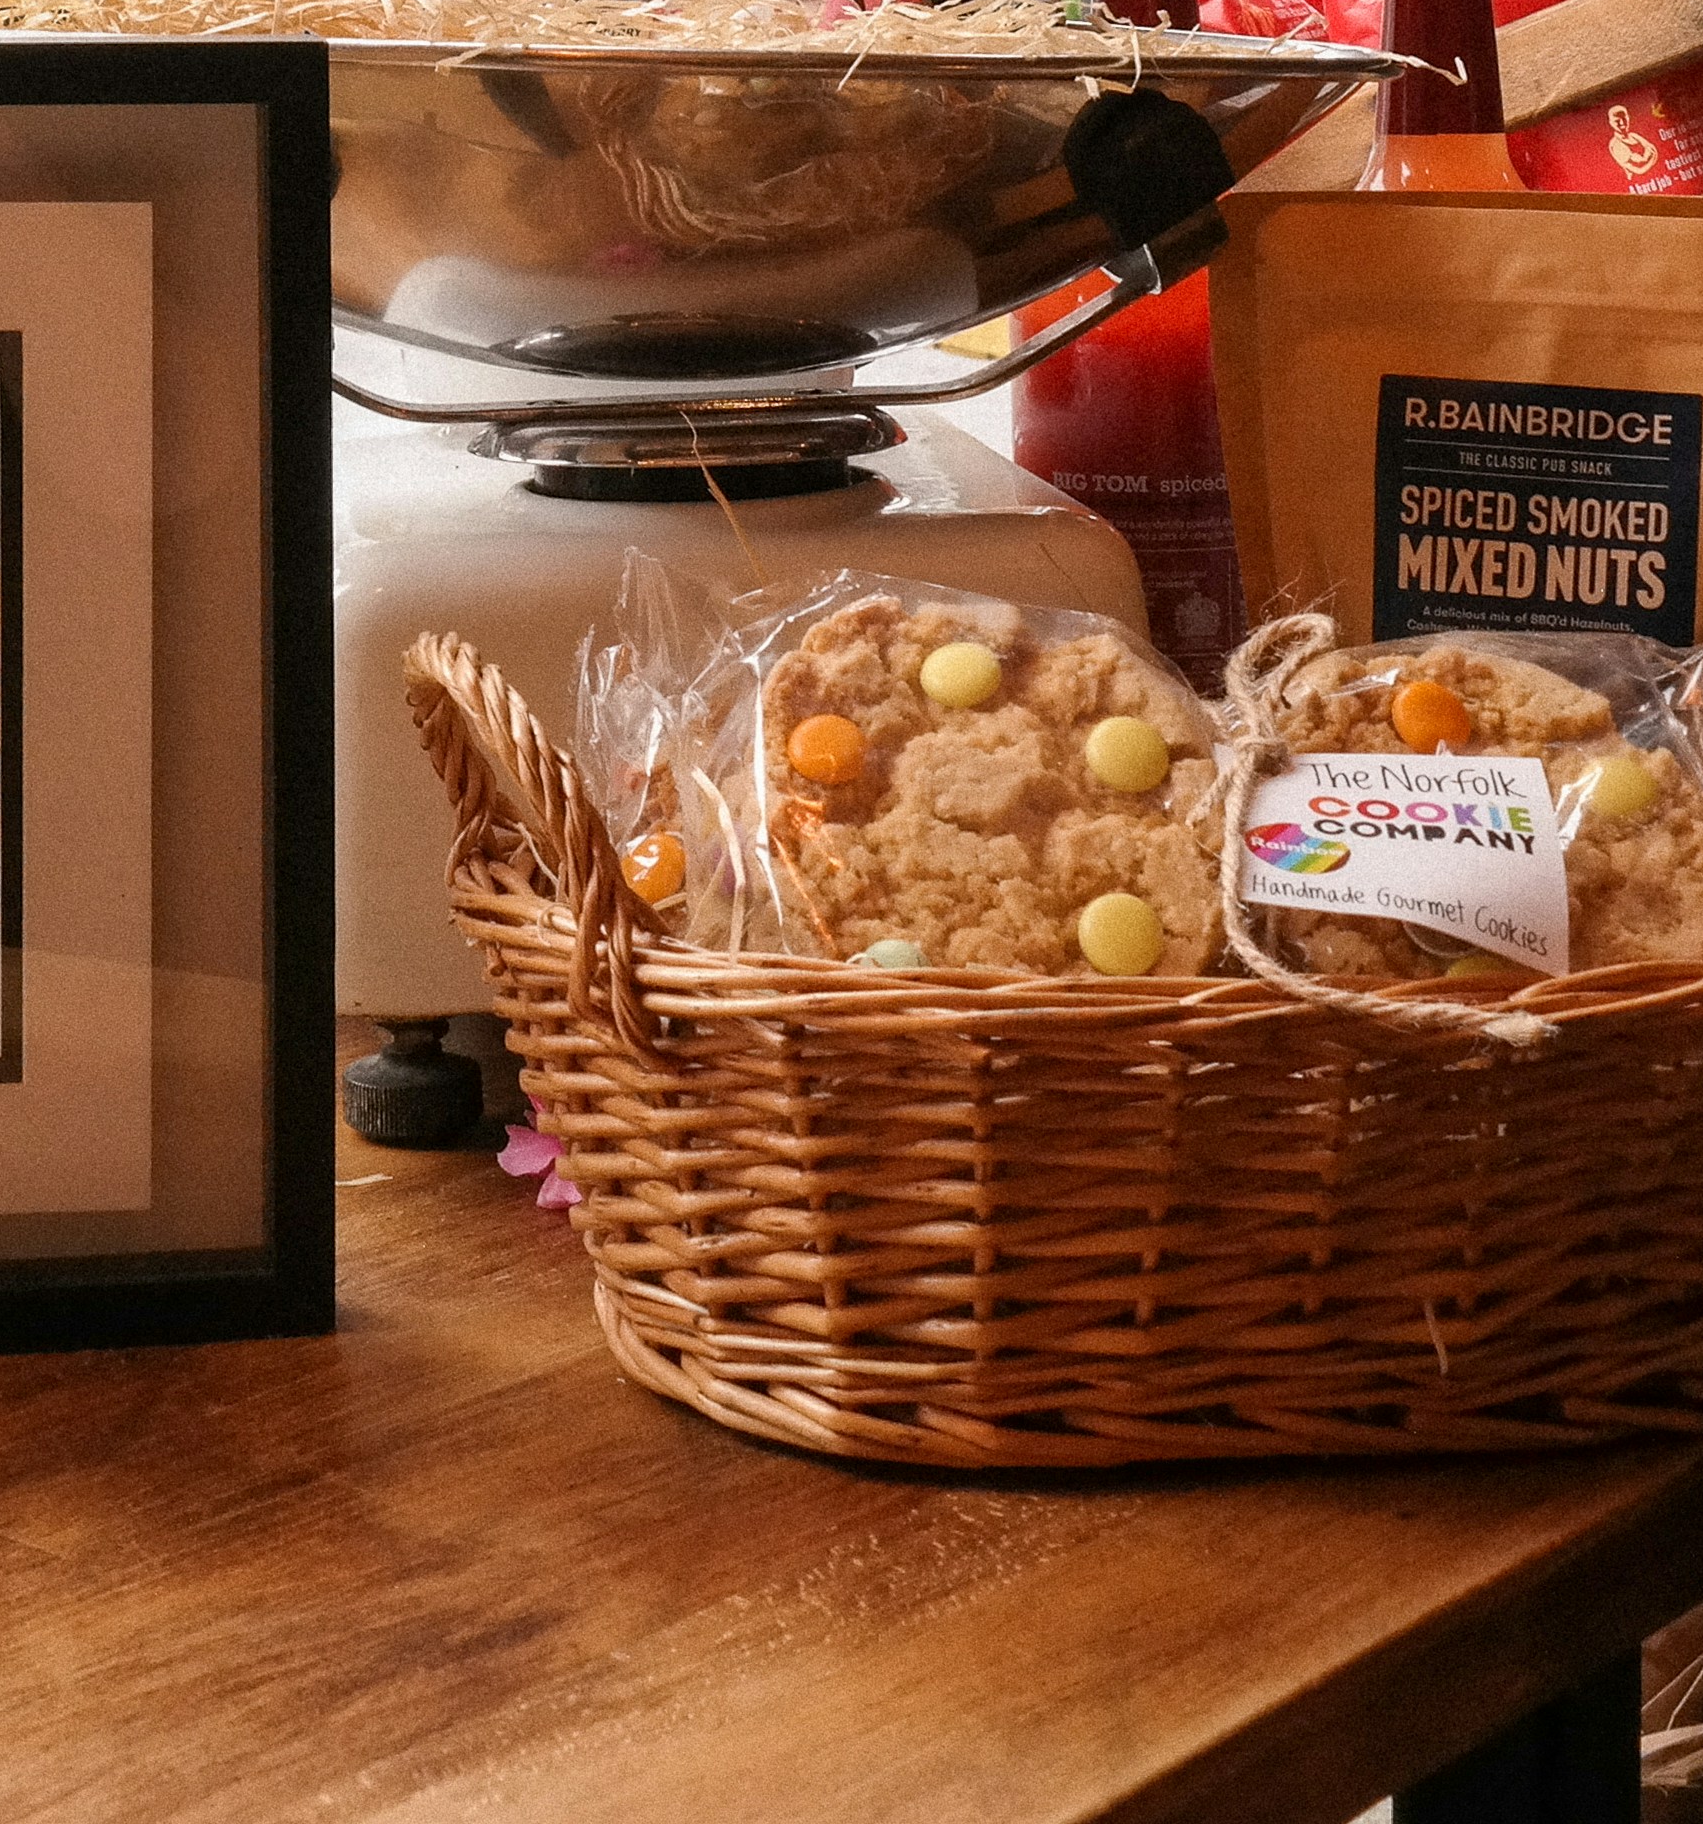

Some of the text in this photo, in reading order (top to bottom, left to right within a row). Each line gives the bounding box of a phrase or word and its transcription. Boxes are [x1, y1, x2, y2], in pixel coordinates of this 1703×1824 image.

[1659, 128, 1676, 142] Our
[1636, 178, 1656, 195] hard
[1655, 174, 1673, 192] job
[1678, 166, 1697, 182] but
[1459, 451, 1612, 476] THE CLASSIC PUB SNACK
[1053, 471, 1228, 497] BIG TOM spiced
[1400, 484, 1669, 543] SPICED SMOKED
[1397, 533, 1667, 610] MIXED NUTS
[1423, 606, 1431, 616] A
[1434, 606, 1486, 621] delicious
[1490, 611, 1510, 623] mix
[1515, 613, 1528, 624] of
[1300, 763, 1528, 798] The Norfolk
[1250, 836, 1345, 858] Rainbow
[1312, 818, 1536, 855] COMPANY
[1251, 873, 1550, 957] Handmade Gourmet Cookies
